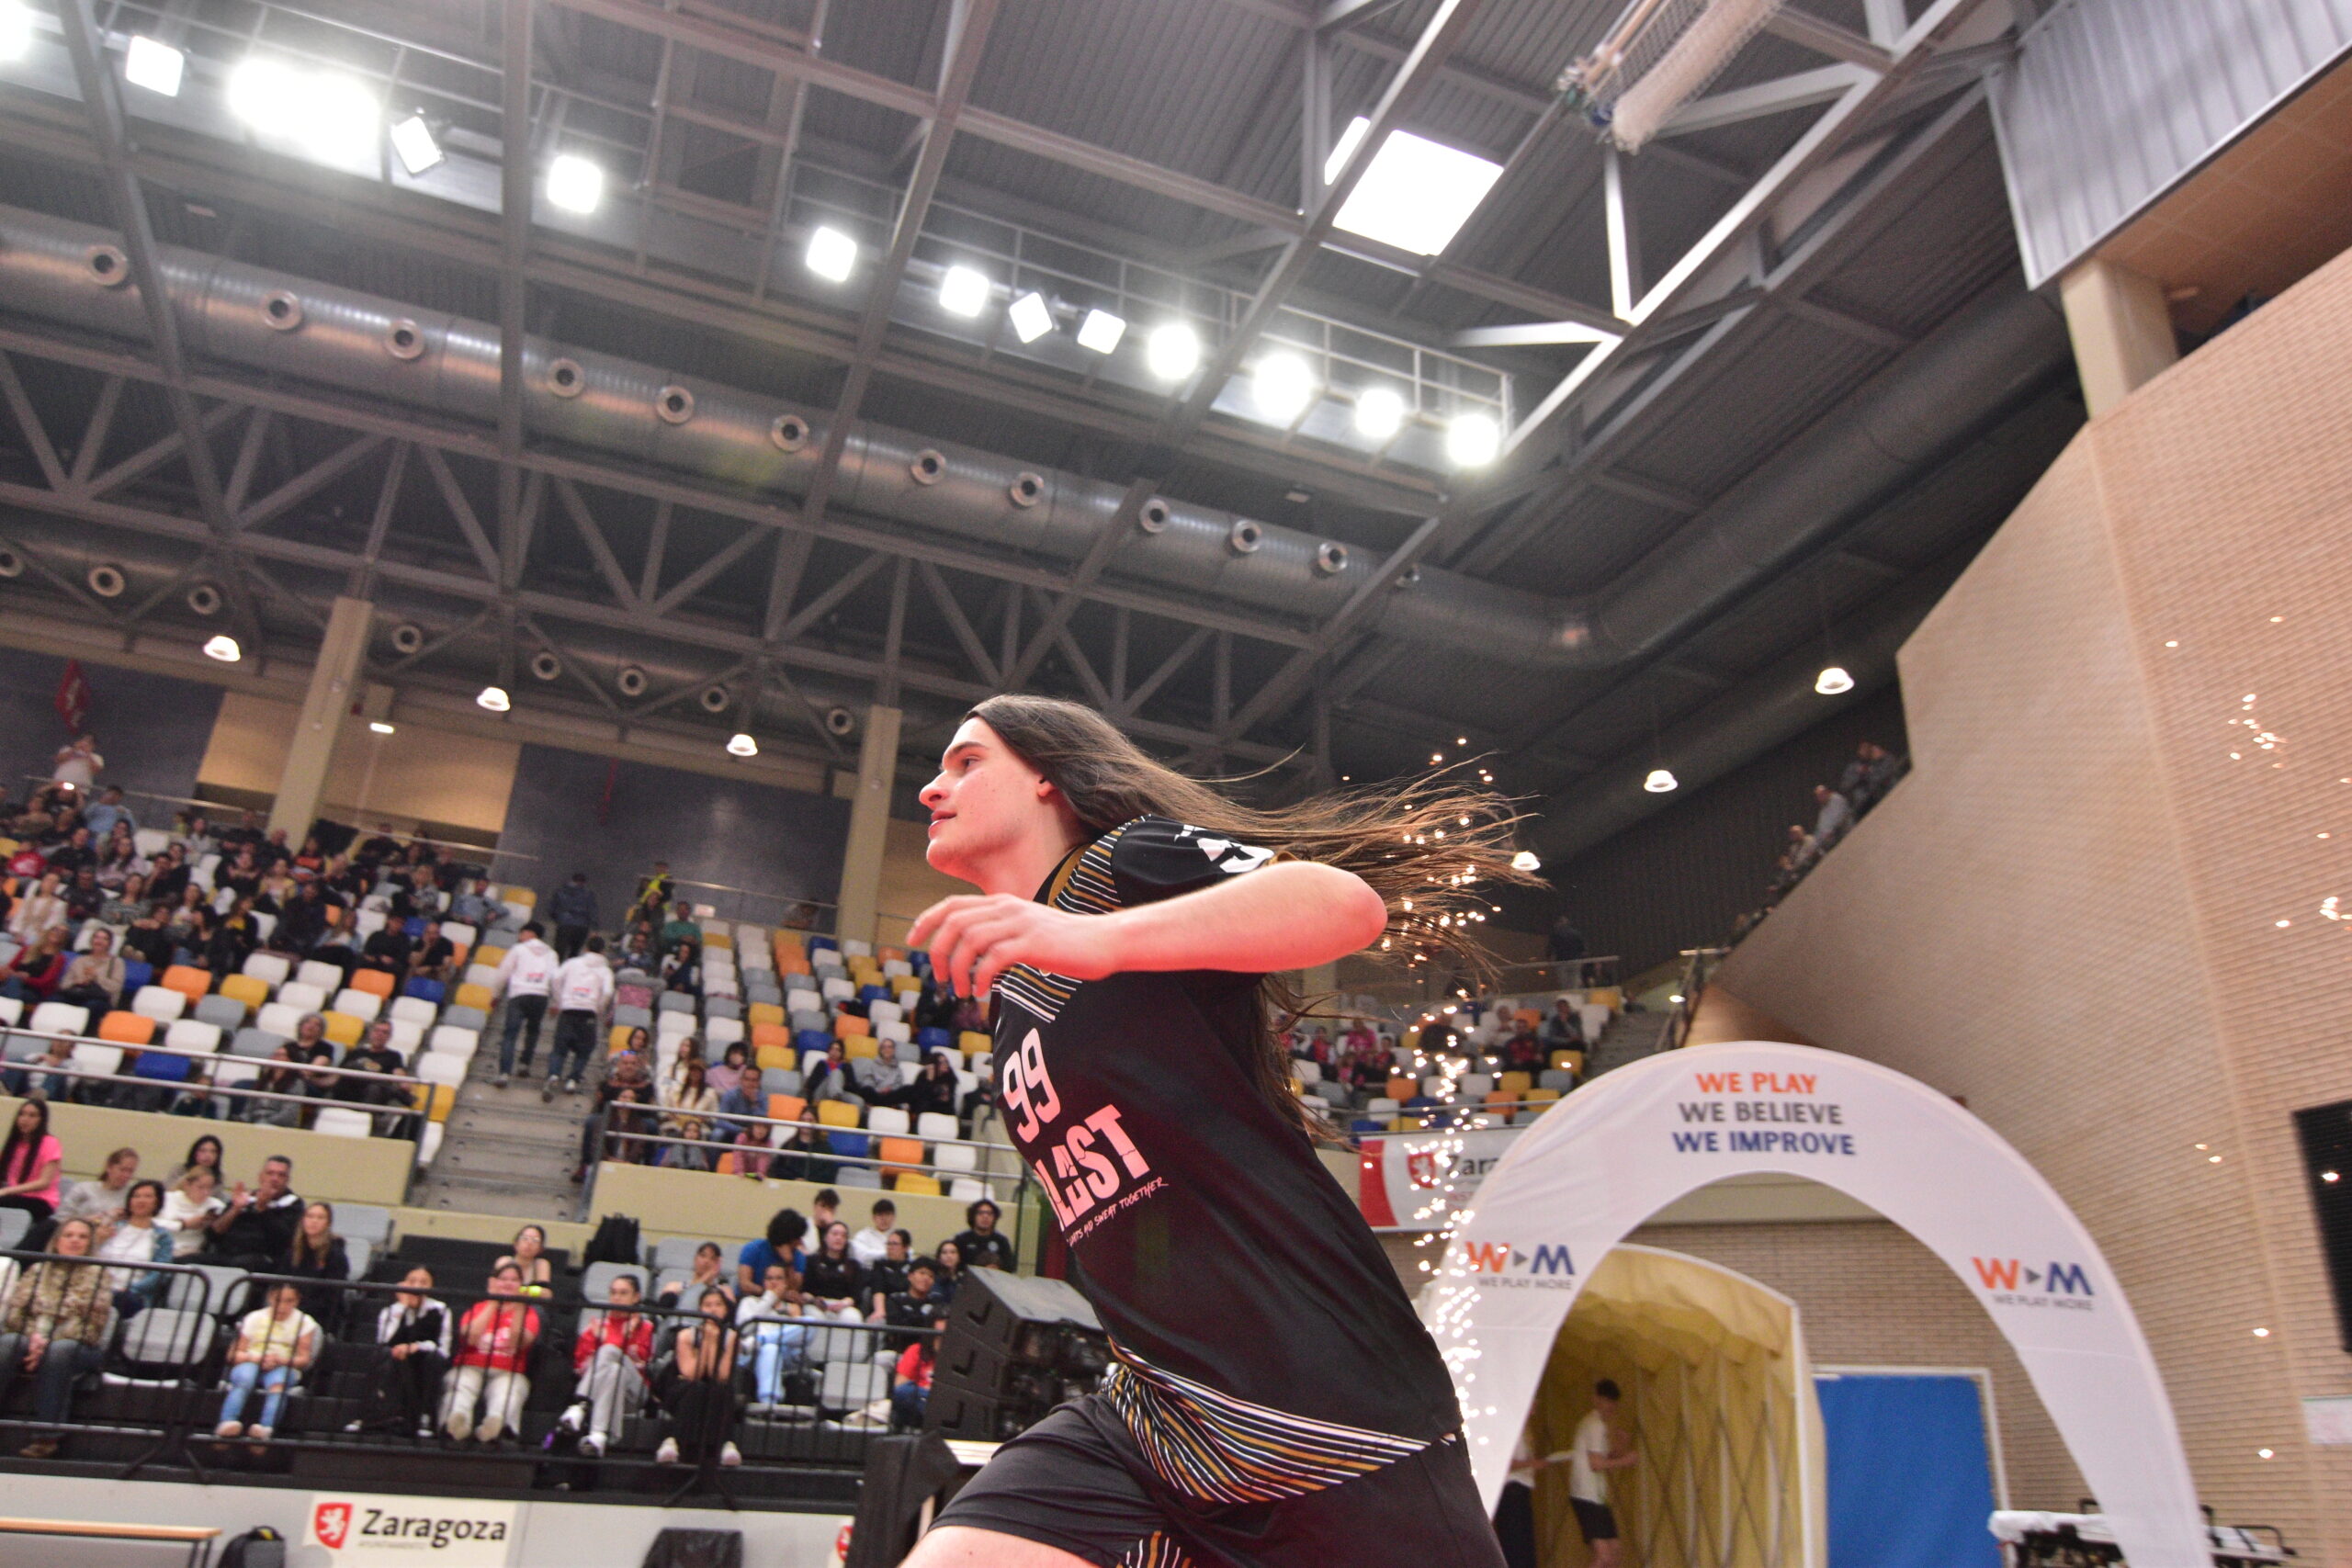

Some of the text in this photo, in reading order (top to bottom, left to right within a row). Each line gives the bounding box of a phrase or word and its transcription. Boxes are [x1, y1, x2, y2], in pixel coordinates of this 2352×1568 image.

[1003, 1027, 1061, 1144] 99
[1695, 1072, 1817, 1094] WE PLAY
[1679, 1101, 1843, 1124] WE BELIEVE
[1672, 1131, 1856, 1156] WE IMPROVE
[1034, 1104, 1150, 1232] LAST
[1094, 1202, 1118, 1226] SWEAT
[1118, 1176, 1170, 1210] TOGETHER
[1477, 1277, 1573, 1290] WE PLAY MORE
[1992, 1293, 2094, 1312] WE PLAY MORE
[360, 1507, 507, 1549] Zaragoza
